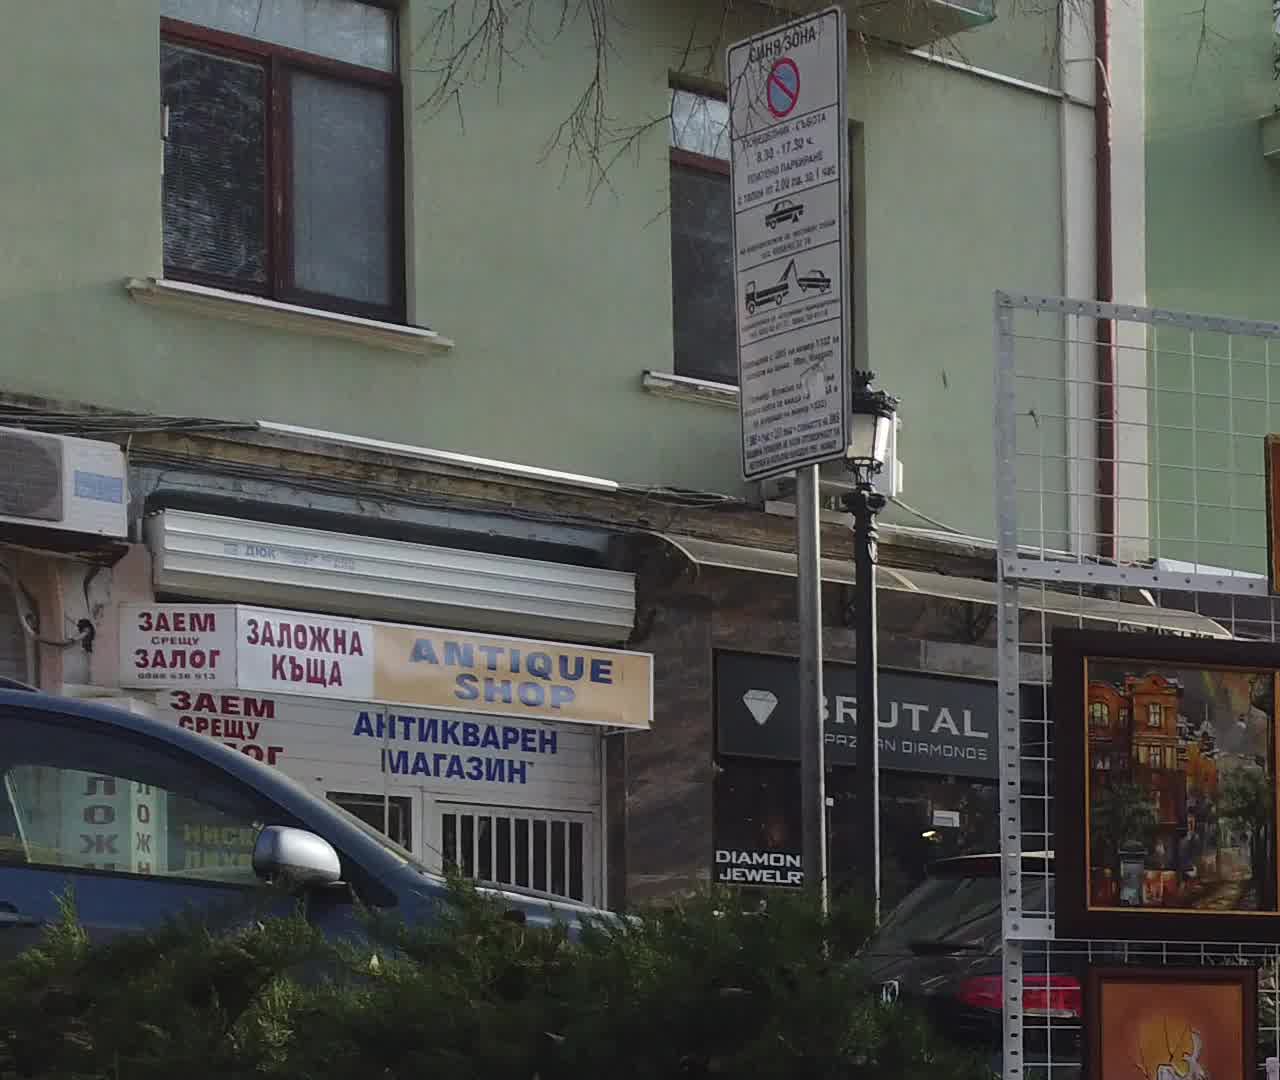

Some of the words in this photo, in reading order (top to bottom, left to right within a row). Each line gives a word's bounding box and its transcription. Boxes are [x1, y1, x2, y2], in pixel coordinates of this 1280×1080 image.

[784, 26, 816, 51] ЗОНА
[138, 612, 216, 632] ЗАЕМ
[151, 636, 200, 646] СРЕЩУ
[247, 618, 364, 656] ЗАЛОЖНА
[134, 648, 220, 669] ЗАЛОГ
[271, 654, 344, 688] КЪЩА
[408, 638, 614, 685] ANTIQUE
[453, 673, 577, 709] SHOP
[170, 690, 276, 719] ЗАЕМ
[179, 715, 260, 740] СРЕЩУ
[352, 710, 558, 755] АНТИКВАРЕН
[901, 741, 989, 761] DIAMONDS
[715, 849, 801, 868] DIAMON
